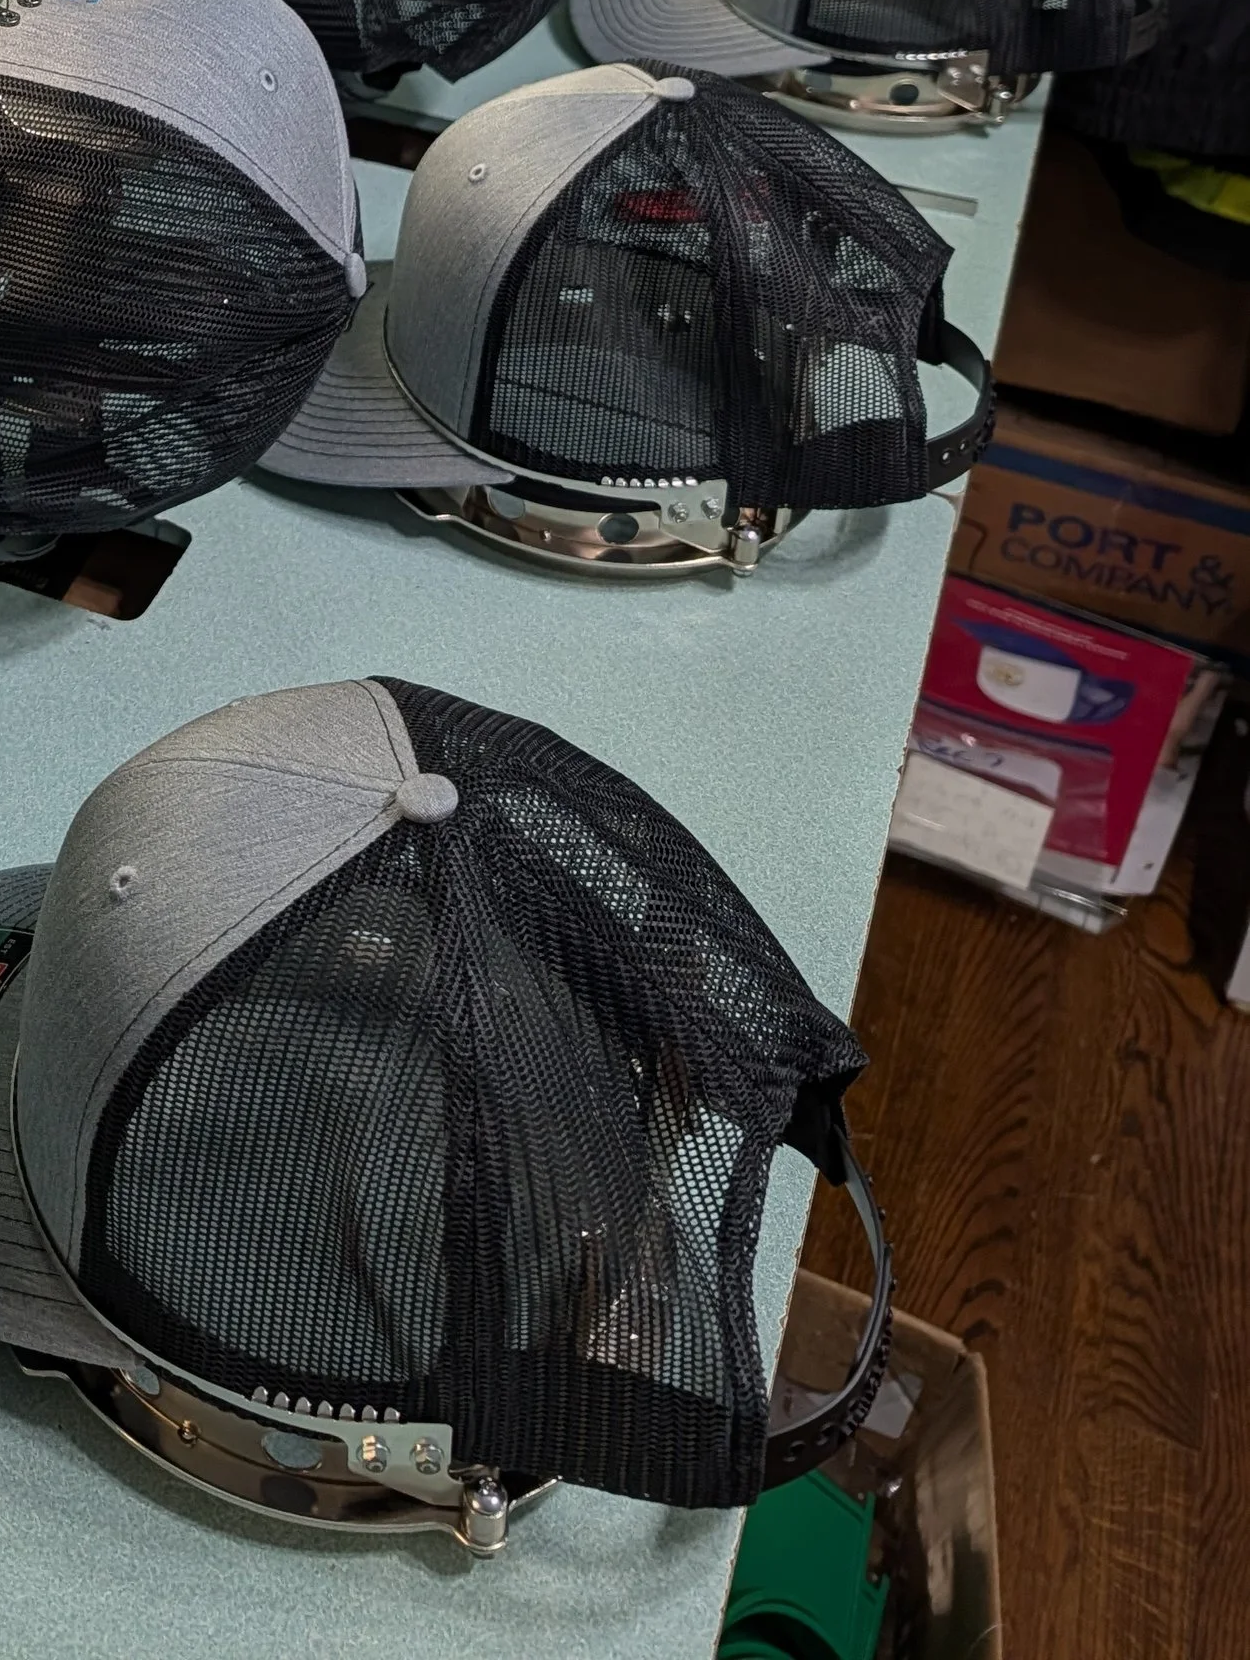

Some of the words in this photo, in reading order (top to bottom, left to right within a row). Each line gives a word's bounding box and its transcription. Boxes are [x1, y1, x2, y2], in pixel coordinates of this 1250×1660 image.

[1000, 535, 1230, 616] COMPANY
[1007, 501, 1183, 572] PORT
[1189, 554, 1236, 590] &
[0, 938, 16, 954] EST
